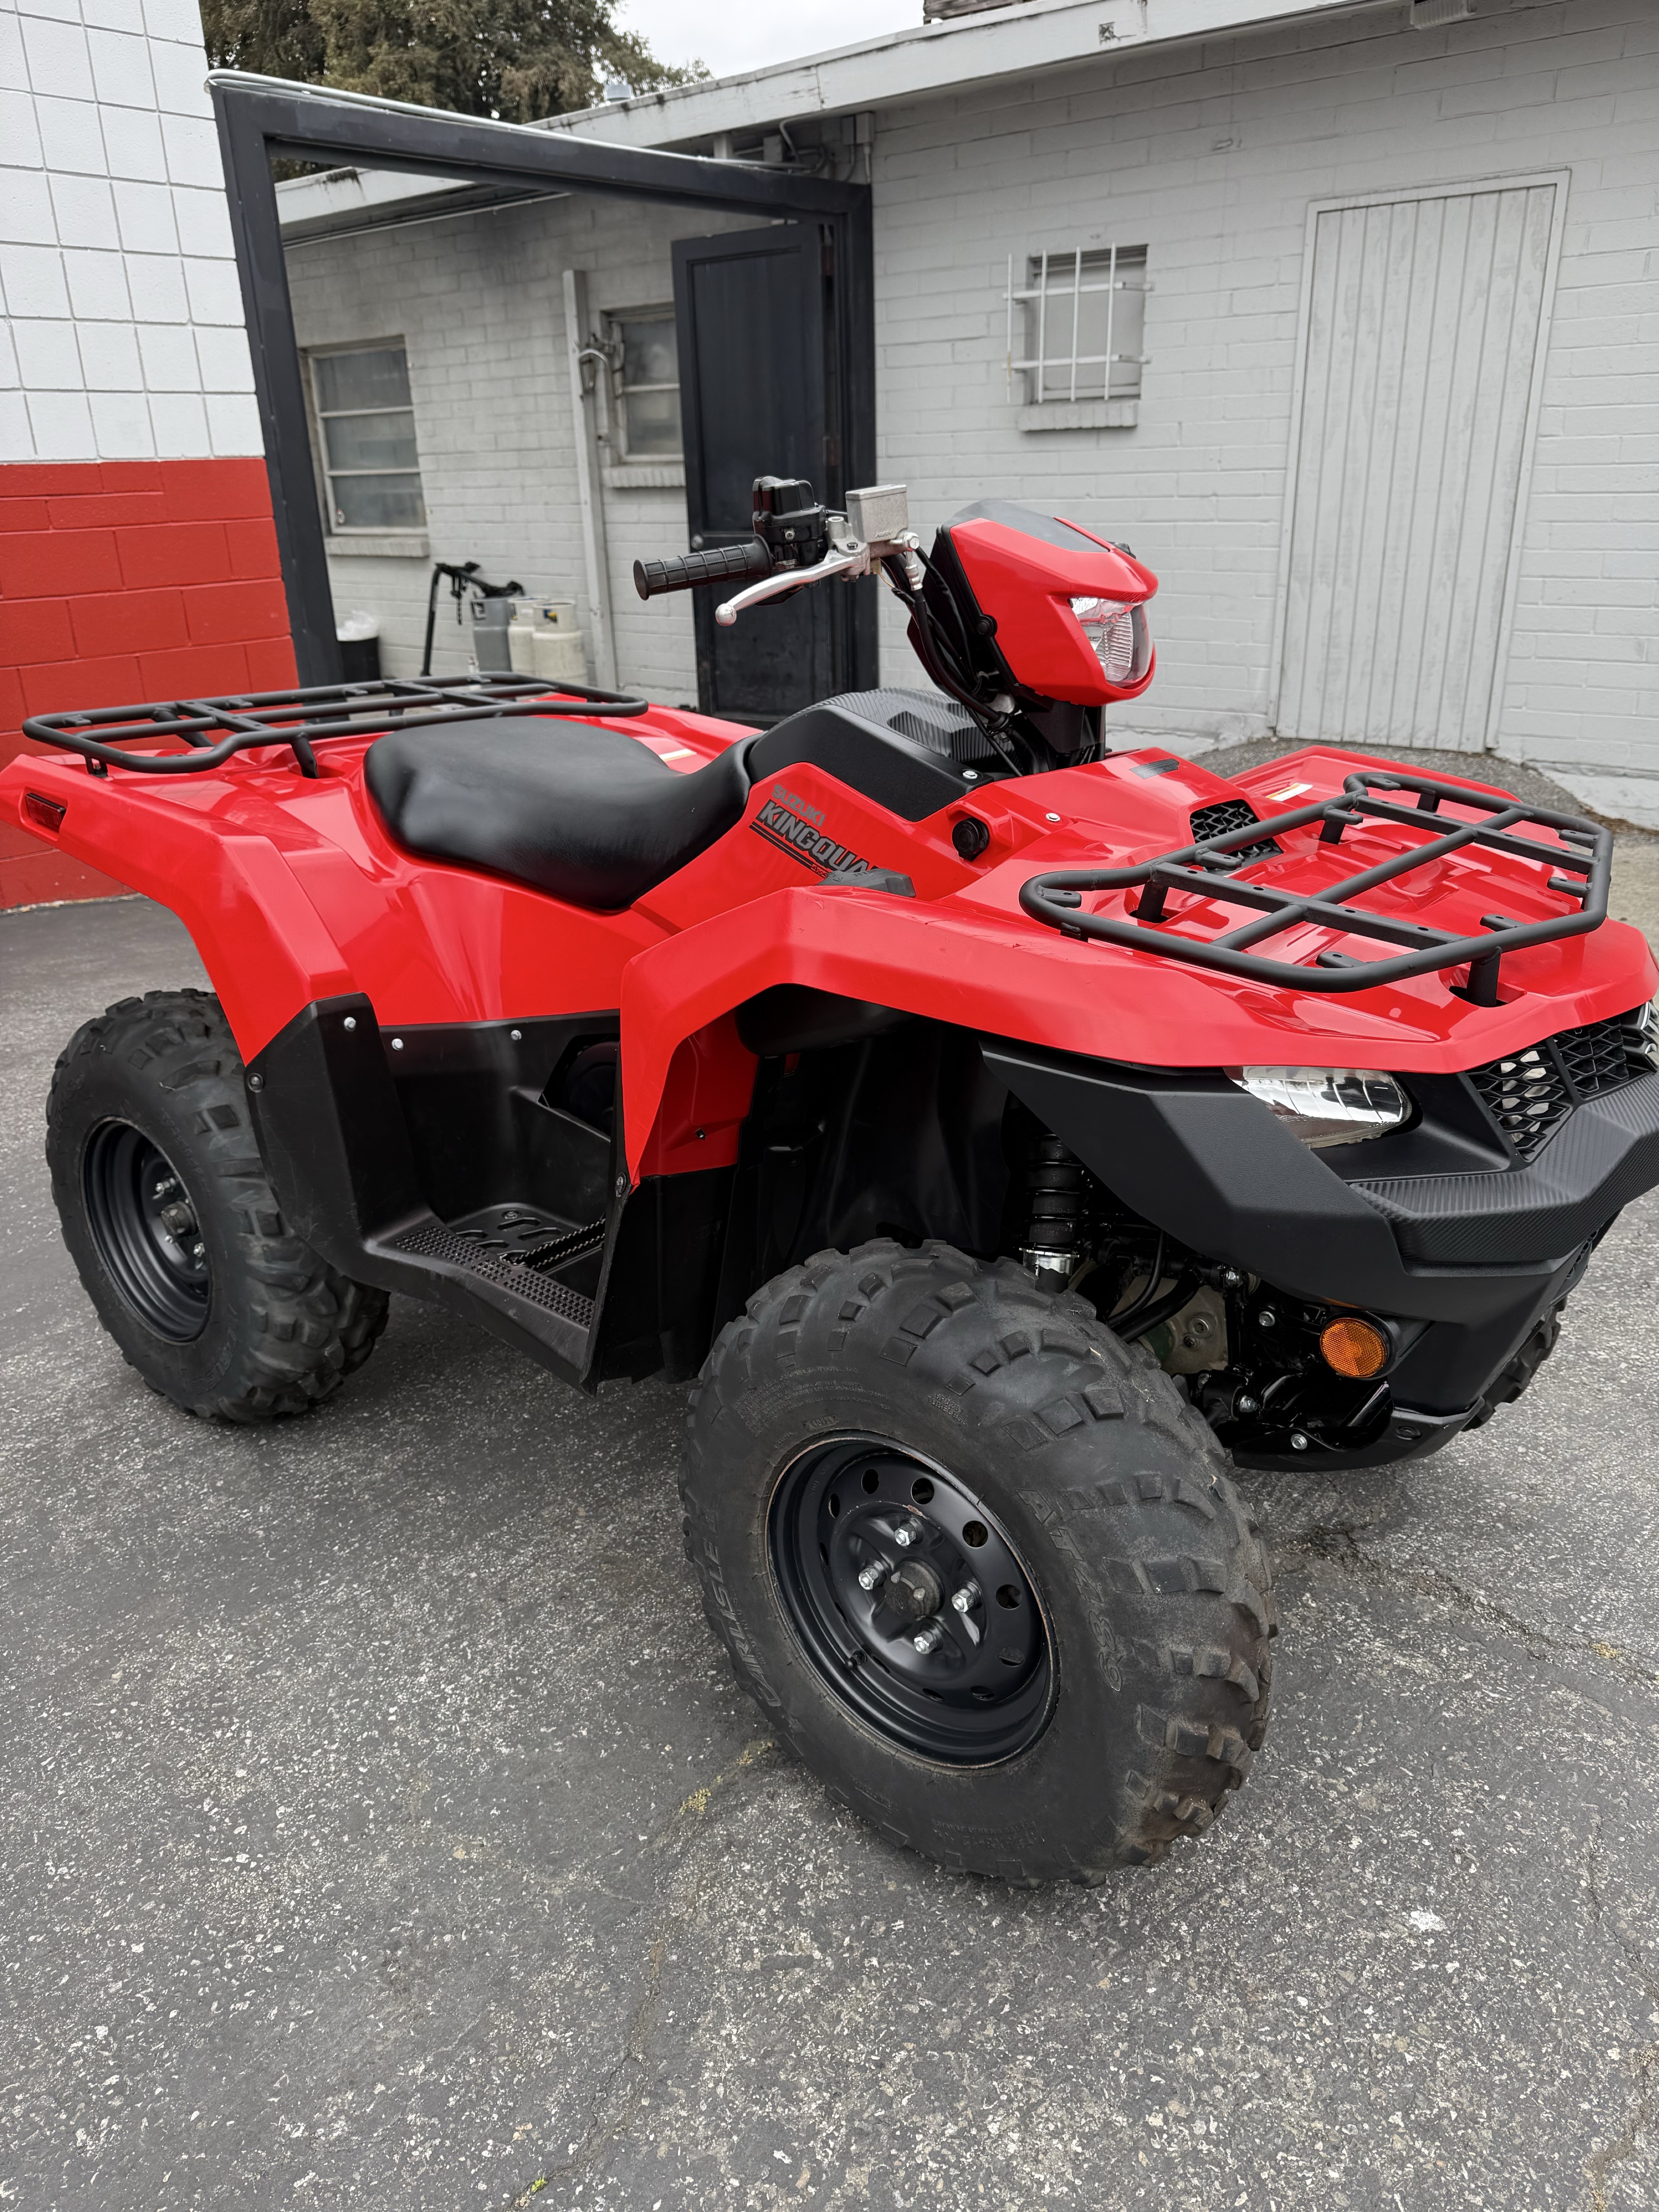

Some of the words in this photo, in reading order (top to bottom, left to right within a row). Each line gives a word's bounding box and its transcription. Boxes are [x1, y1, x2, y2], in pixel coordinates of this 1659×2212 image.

[756, 799, 878, 873] KINGQUA
[771, 784, 826, 827] SUZUKI
[927, 1395, 968, 1427] TUBELESS
[705, 1540, 782, 1707] CARLISLE
[1015, 1488, 1123, 1692] AT489
